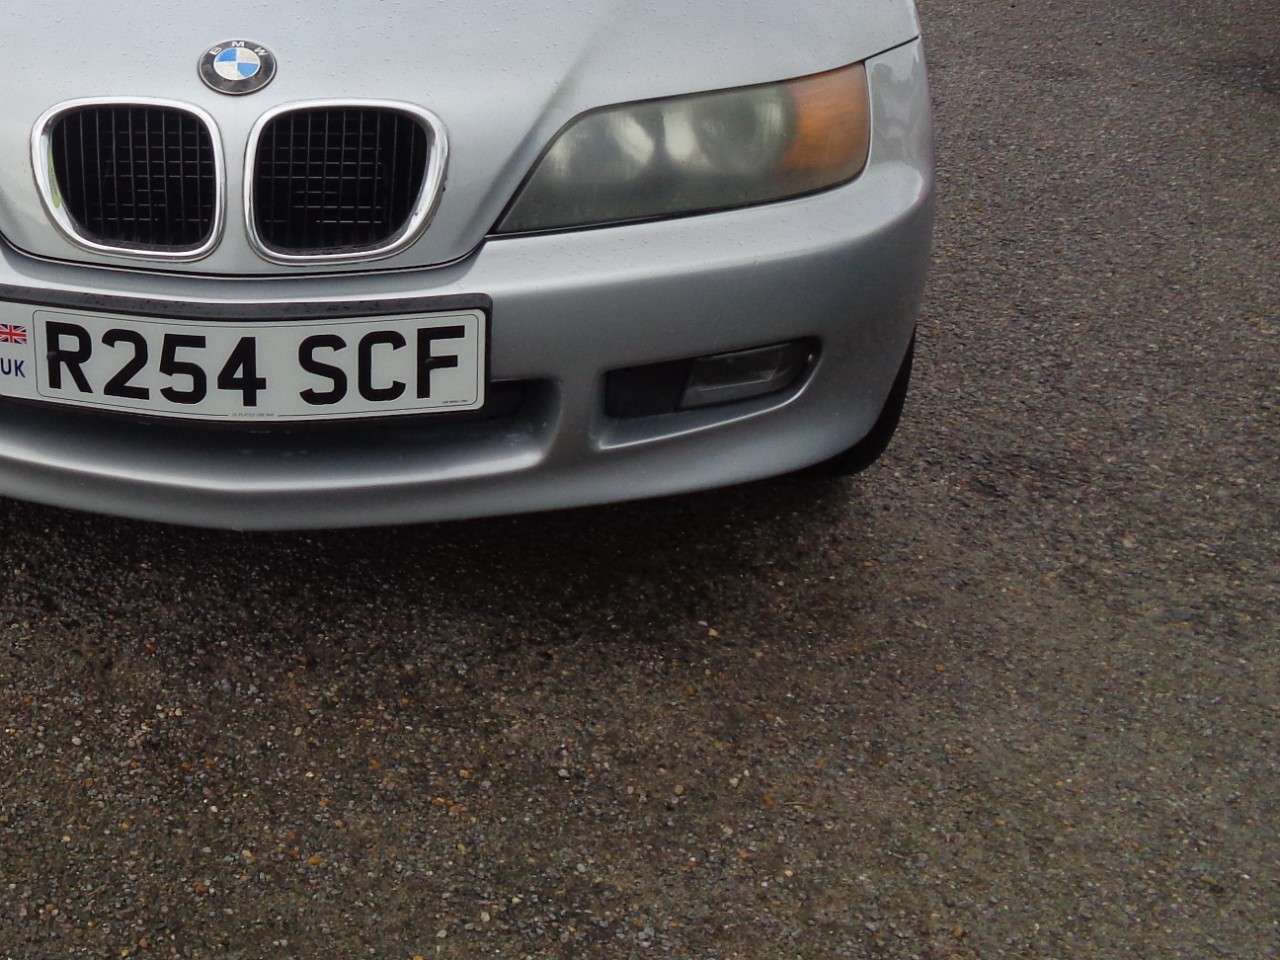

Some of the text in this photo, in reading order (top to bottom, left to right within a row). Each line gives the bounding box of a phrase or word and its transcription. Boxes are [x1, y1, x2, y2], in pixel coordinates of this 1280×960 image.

[209, 41, 269, 56] BMW
[0, 320, 466, 407] UK R254 SCF
